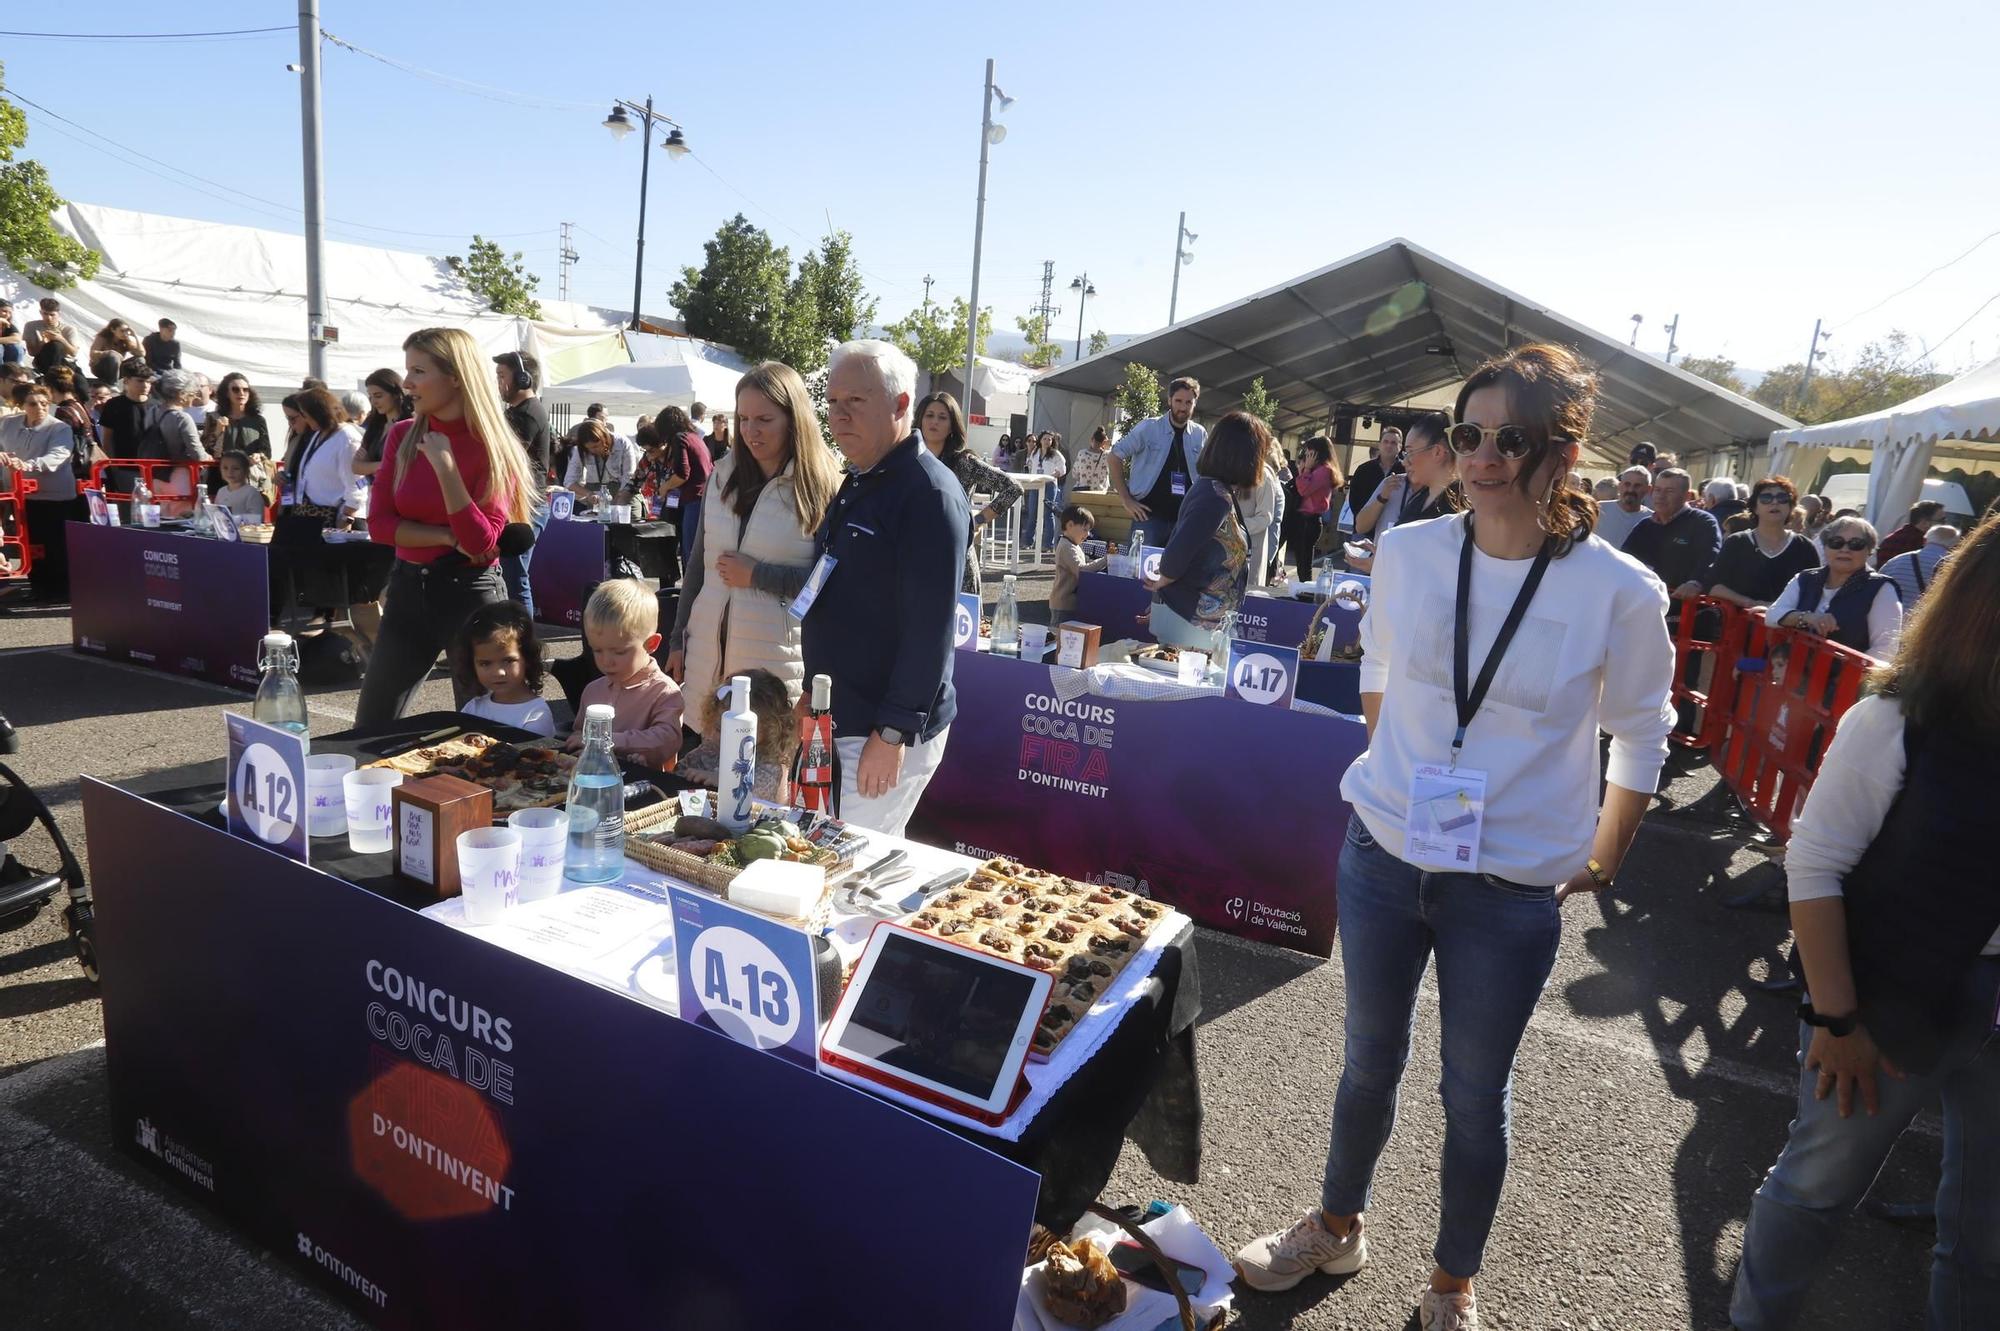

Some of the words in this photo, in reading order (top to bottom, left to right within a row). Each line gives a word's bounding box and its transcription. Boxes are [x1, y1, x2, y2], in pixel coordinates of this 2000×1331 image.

[554, 502, 569, 514] A.19
[143, 550, 178, 565] CONCURS
[955, 611, 970, 637] 16
[1236, 612, 1268, 627] CURS
[1239, 662, 1284, 693] A.17
[1025, 693, 1116, 725] CONCURS
[1021, 713, 1080, 742] COCA
[1083, 725, 1114, 748] DE
[1020, 733, 1110, 783] FIRA
[243, 763, 292, 824] A.12
[1018, 768, 1109, 798] D'ONTINYENT
[1104, 870, 1150, 898] FIRA
[1251, 915, 1264, 926] de
[1266, 917, 1307, 936] València
[1253, 902, 1301, 922] Diputació
[704, 946, 790, 1027] A.13
[366, 959, 513, 1052] CONCURS
[366, 1001, 459, 1079] COCA
[465, 1045, 514, 1106] DE
[164, 1149, 215, 1192] Ontinyent
[372, 1111, 515, 1211] D'ONTINYENT
